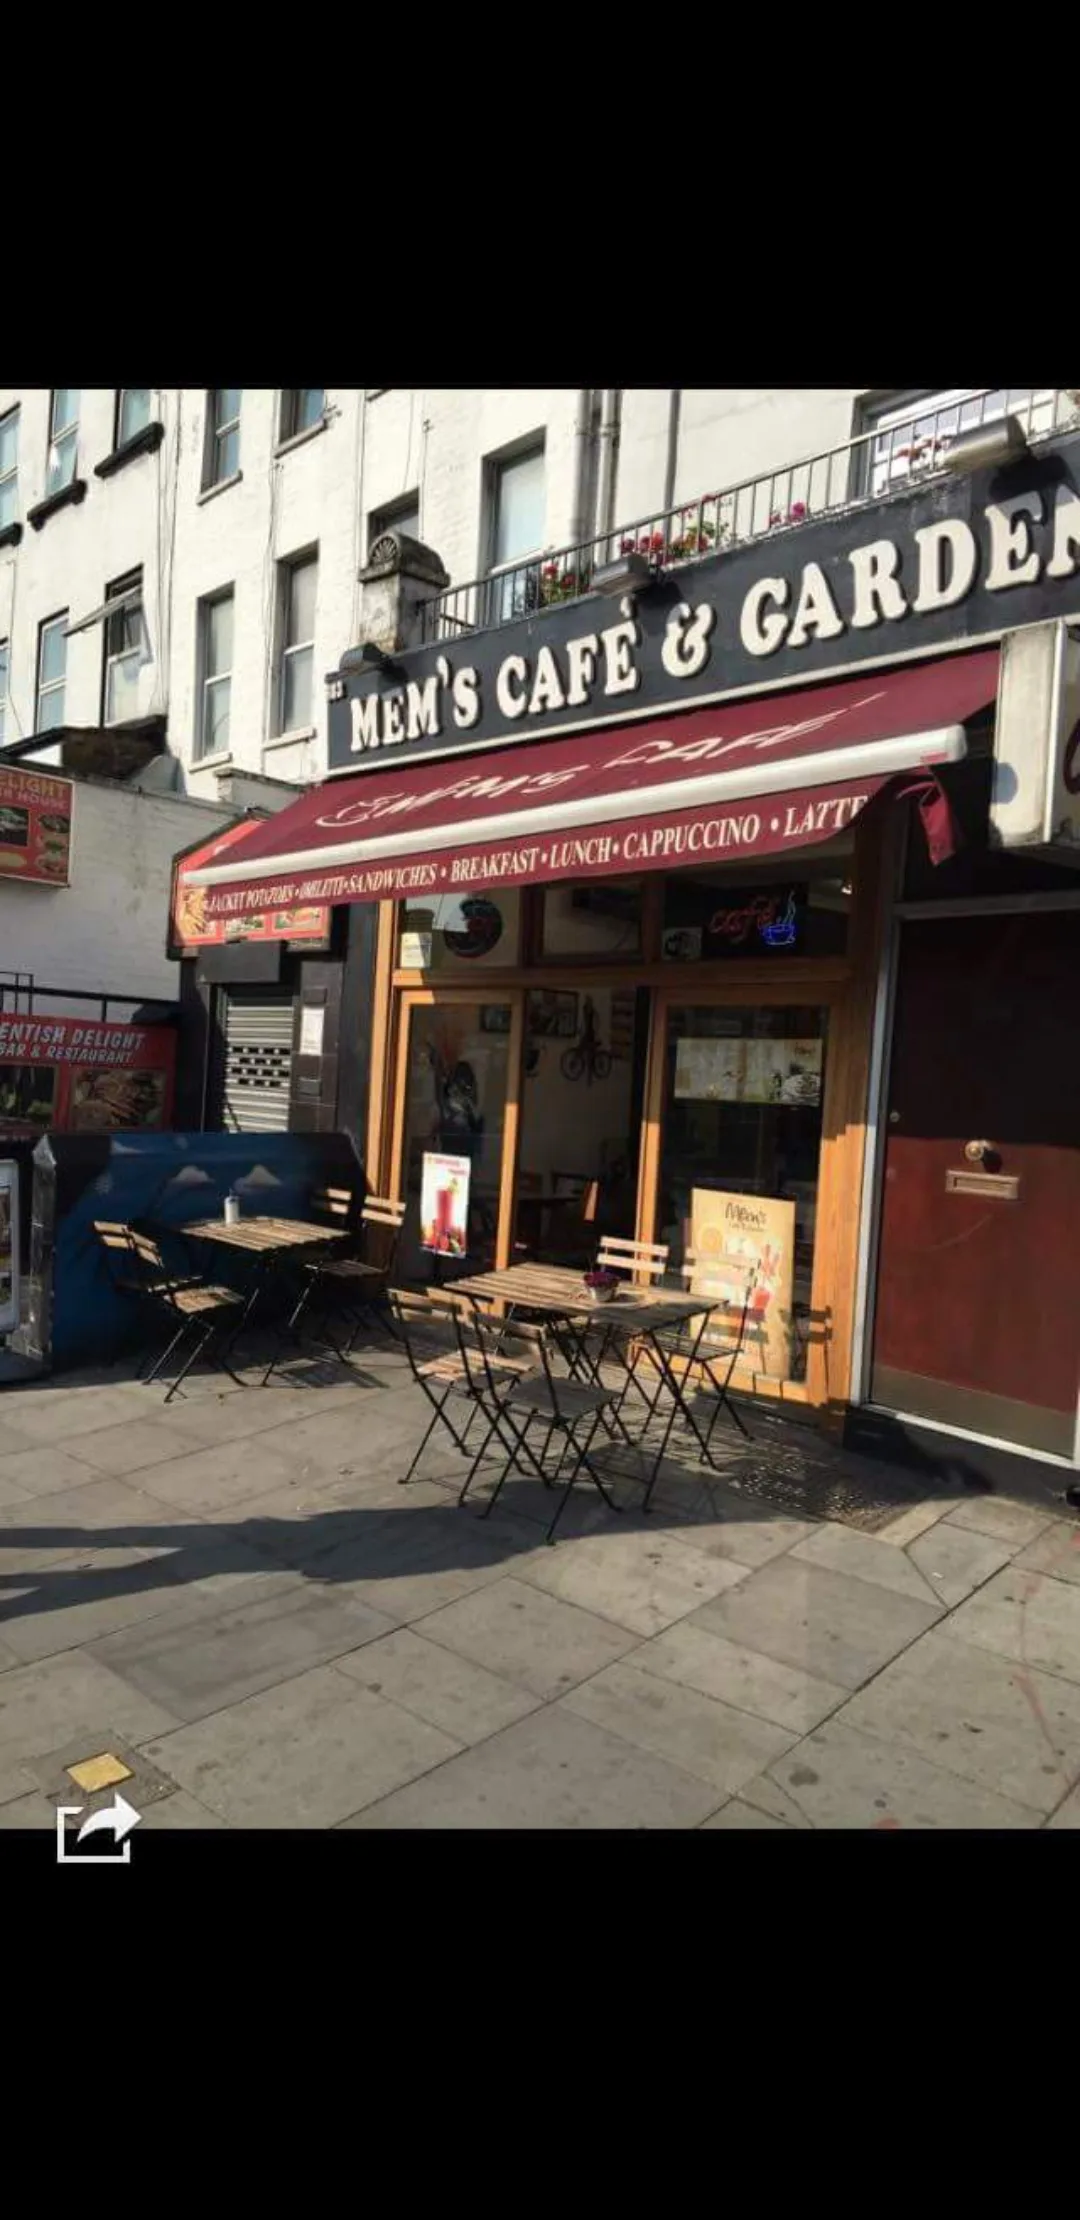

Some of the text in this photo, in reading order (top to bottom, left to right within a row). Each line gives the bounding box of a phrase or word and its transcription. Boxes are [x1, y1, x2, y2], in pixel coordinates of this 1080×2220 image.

[350, 654, 479, 751] MEM'S
[661, 601, 714, 678] &
[346, 864, 438, 894] SANDWICHES
[450, 847, 540, 883] BREAKFAST
[550, 837, 612, 869] LUNCH
[623, 814, 760, 860] CAPPUCCINO
[46, 1045, 134, 1064] RESTAURANT
[71, 1028, 145, 1051] DELIGHT
